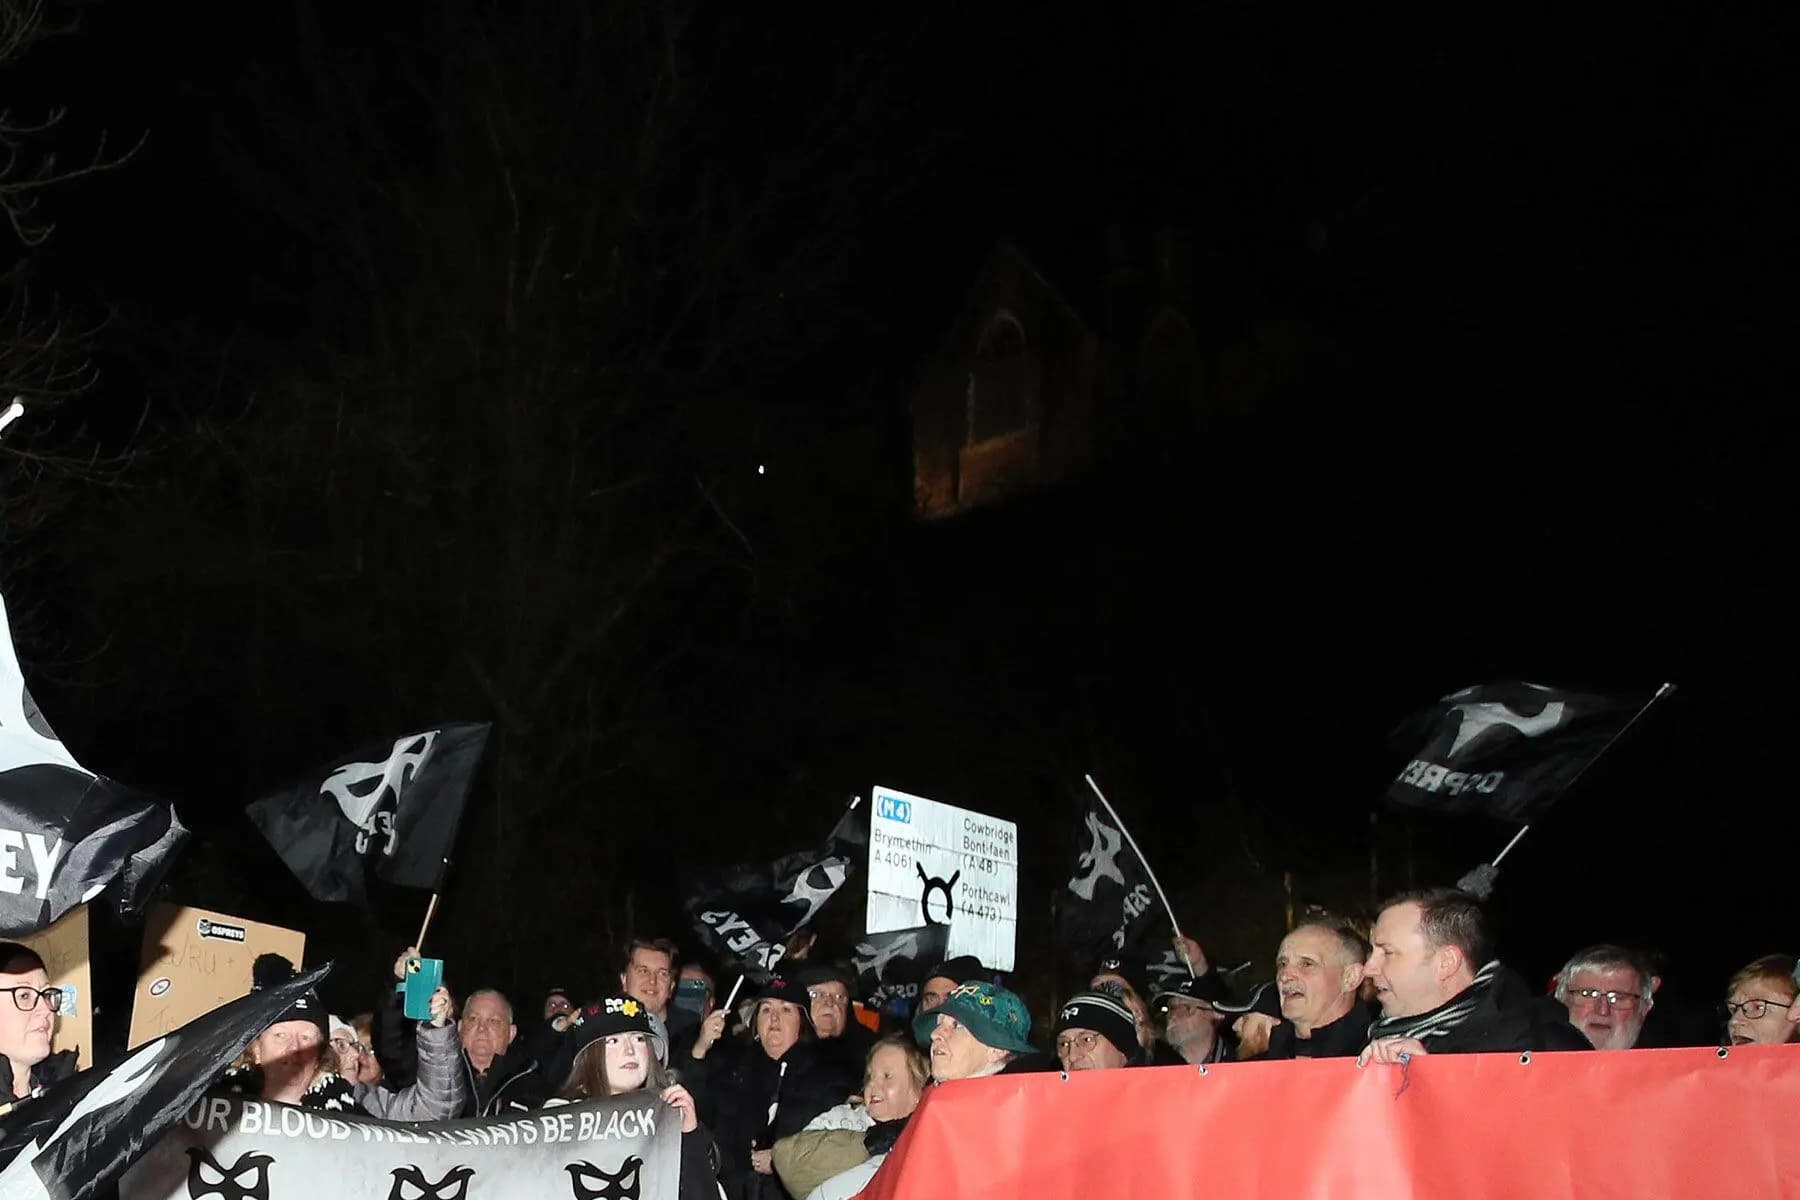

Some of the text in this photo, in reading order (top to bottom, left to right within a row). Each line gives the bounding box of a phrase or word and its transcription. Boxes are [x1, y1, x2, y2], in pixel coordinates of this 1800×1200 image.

[963, 818, 1014, 843] Cowbridge
[962, 882, 1011, 906] Porthcawl
[211, 926, 244, 940] OSPREYS
[183, 1098, 232, 1132] UR
[239, 1102, 351, 1141] BLOOD
[541, 1113, 575, 1143] BE
[577, 1108, 656, 1141] BLACK
